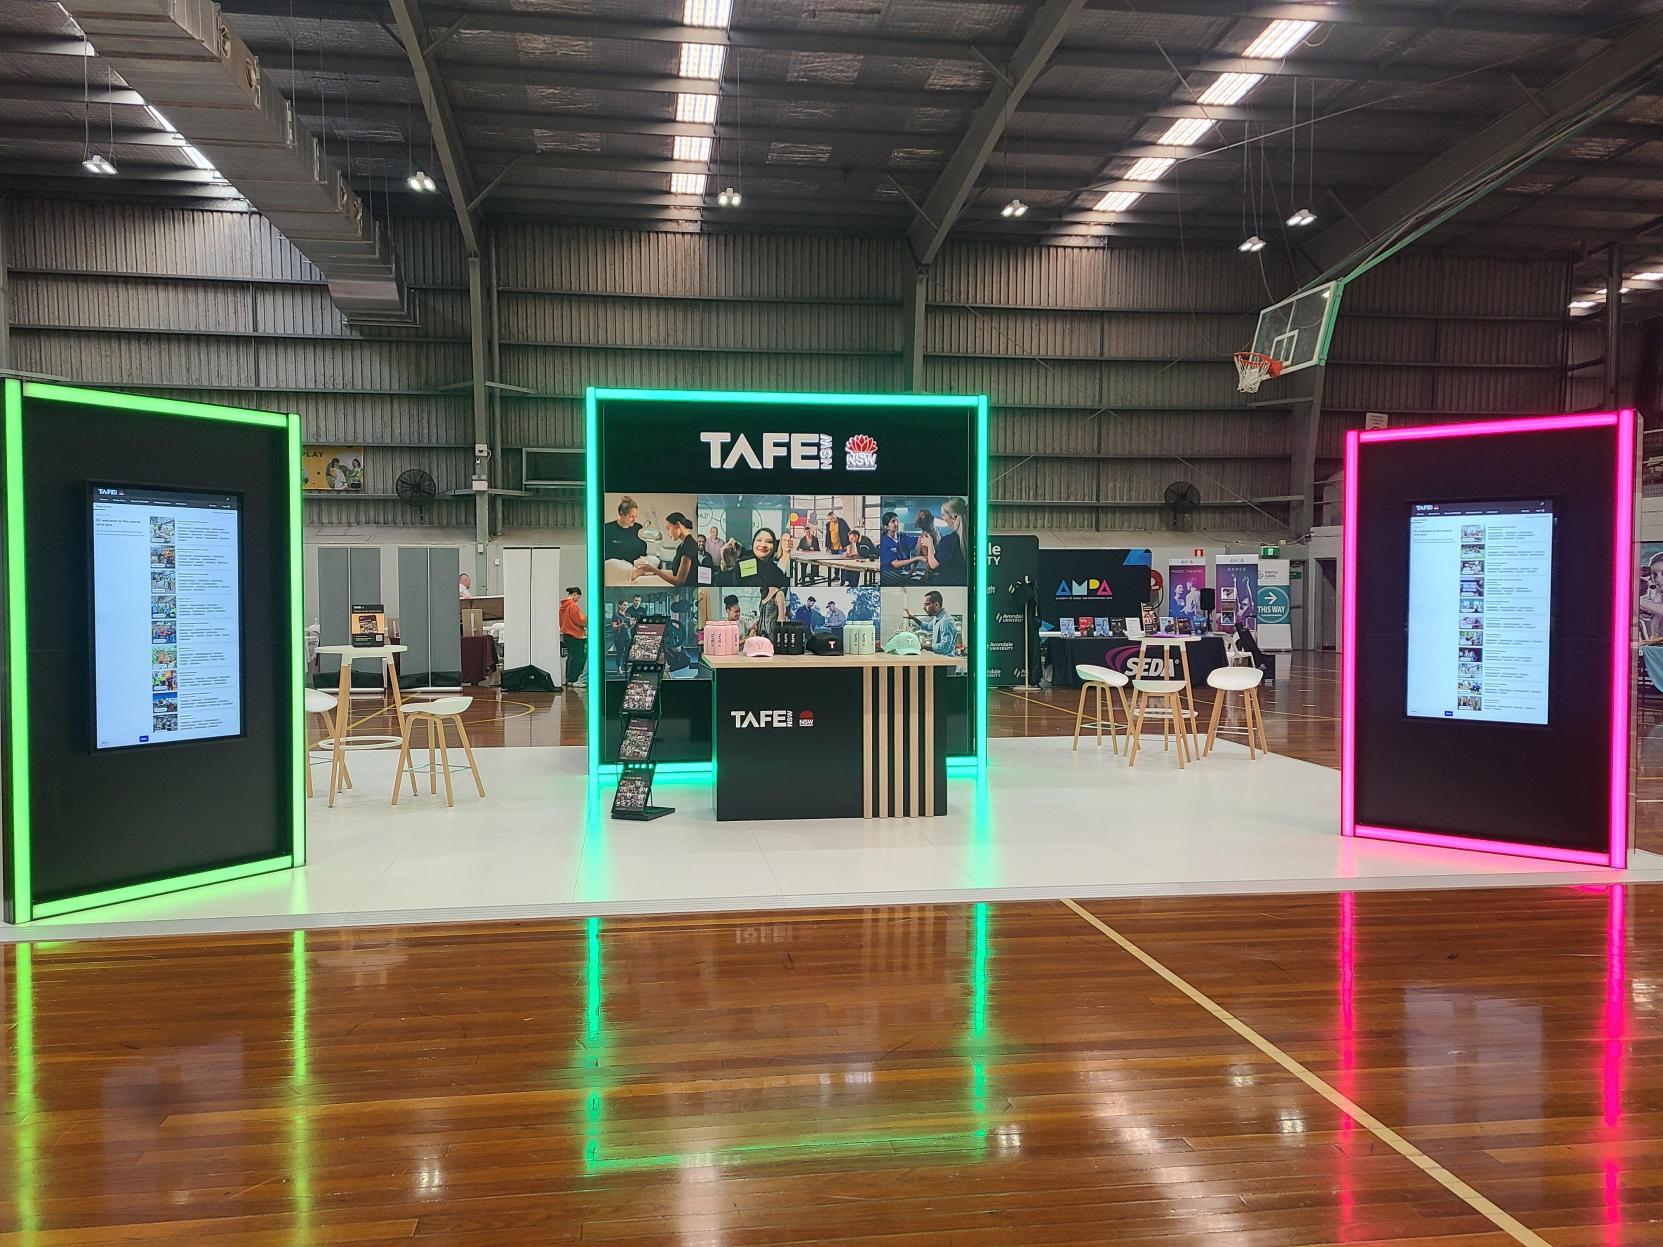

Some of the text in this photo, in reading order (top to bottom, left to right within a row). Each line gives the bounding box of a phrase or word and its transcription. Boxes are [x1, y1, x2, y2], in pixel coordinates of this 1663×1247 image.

[700, 431, 833, 470] TAFE NSW
[846, 452, 878, 466] NSW
[1055, 579, 1113, 596] AMPA
[1257, 605, 1286, 614] THIS WAY
[828, 640, 836, 649] T
[906, 638, 913, 646] T
[730, 710, 787, 728] TAFE
